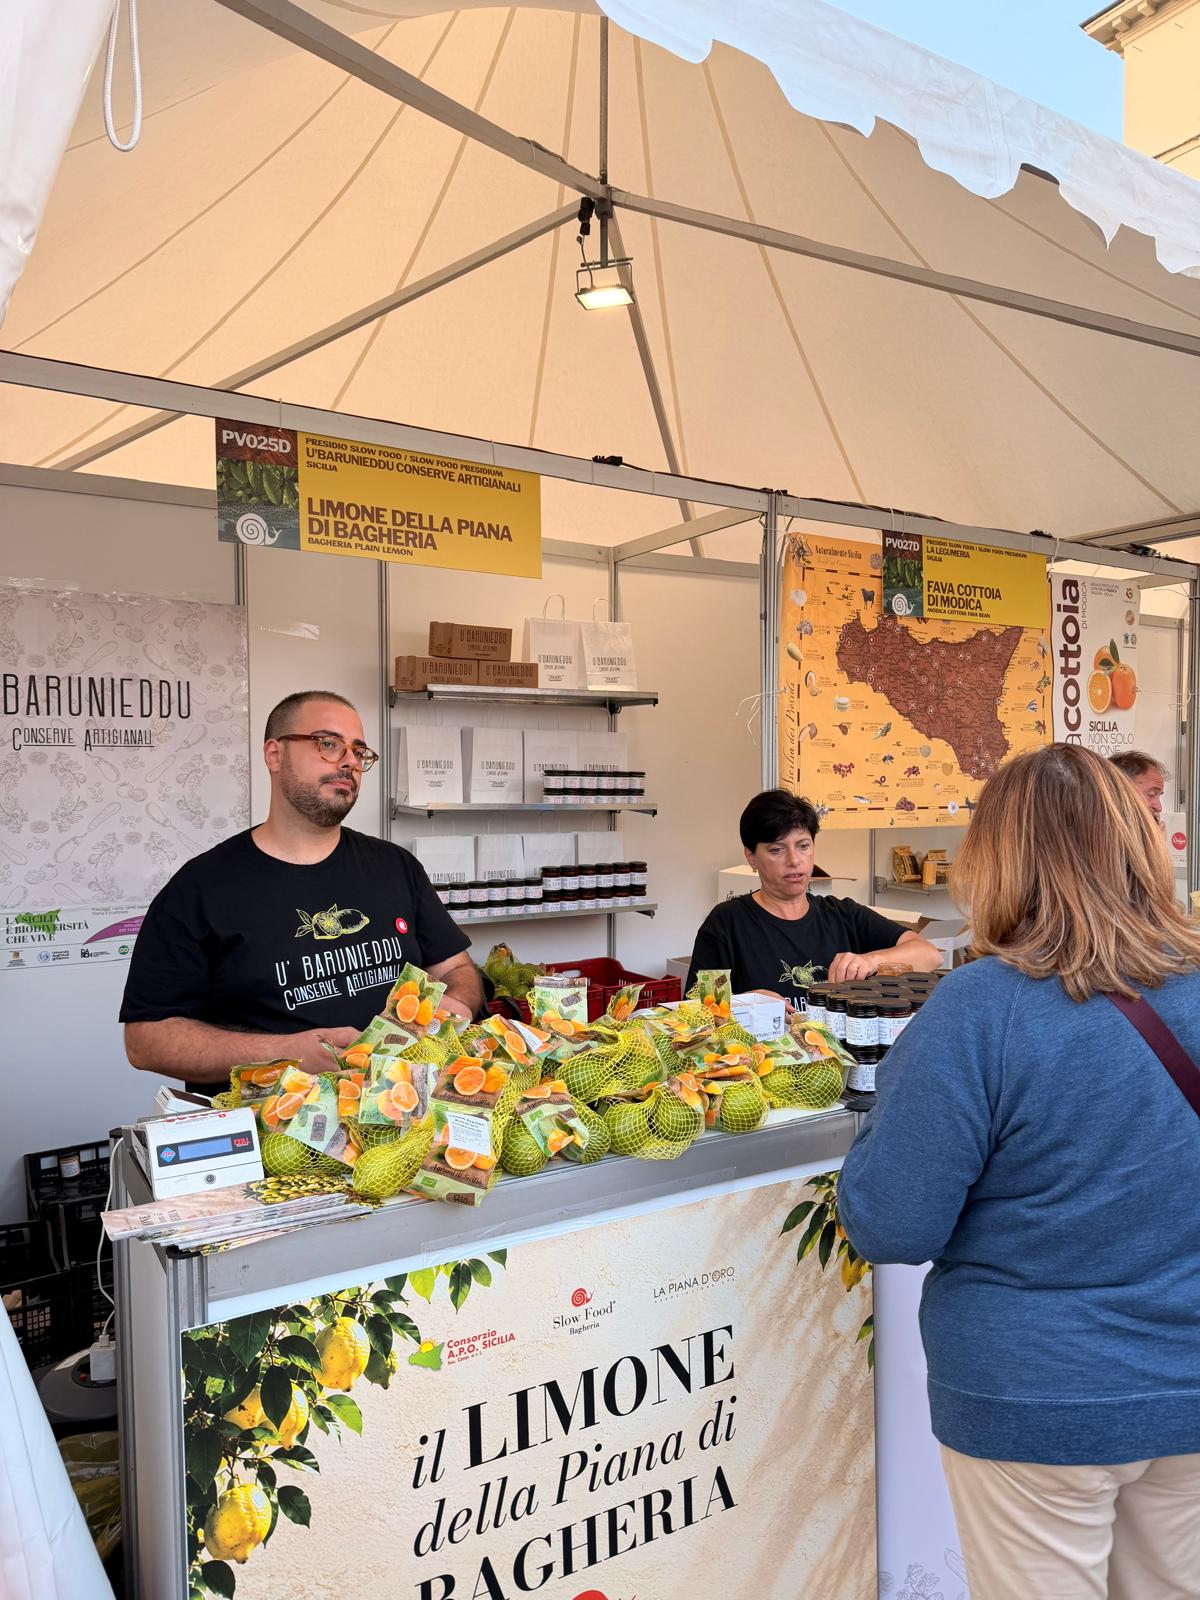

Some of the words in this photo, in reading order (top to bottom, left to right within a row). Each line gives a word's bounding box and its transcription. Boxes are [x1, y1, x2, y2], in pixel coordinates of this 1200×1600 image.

[222, 429, 291, 453] PV025D
[305, 437, 348, 450] PRESIDIO
[350, 445, 376, 455] SLOW
[378, 449, 402, 460] FOOD
[409, 455, 435, 466] SLOW
[436, 460, 459, 470] FOOD
[460, 464, 503, 478] PRESIDIUM
[306, 461, 338, 472] SICILIA
[306, 447, 394, 471] U'BARUNIEDDU
[396, 462, 456, 482] CONSERVE
[457, 472, 521, 493] ARTIGIANALI
[307, 497, 388, 526] LIMONE
[392, 509, 453, 534] DELLA
[457, 518, 513, 542] PIANA
[308, 517, 330, 537] DI
[333, 520, 438, 550] BAGHERIA
[308, 536, 353, 549] BAGHERIA
[354, 542, 380, 553] PLAIN
[382, 546, 414, 557] LEMON
[885, 537, 920, 552] PV027D
[926, 546, 935, 554] LA
[936, 547, 970, 559] LEGUMERIA
[926, 555, 943, 563] SICILIA
[927, 580, 955, 595] FAVA
[957, 584, 1002, 600] COTTOIA
[927, 594, 938, 607] DI
[940, 595, 983, 611] MODICA
[3, 673, 191, 719] BARUNIEDDU
[1089, 721, 1118, 732] SICILIA
[1088, 733, 1108, 744] NON
[1110, 733, 1134, 745] SOLO
[15, 920, 89, 934] BIODIVERSITÀ
[22, 913, 61, 924] SICILIA
[6, 935, 29, 944] CHE
[30, 934, 55, 943] VIVE
[275, 960, 290, 986] U'
[302, 937, 402, 981] BARUNIEDDU
[453, 1193, 468, 1204] Bio
[654, 1287, 666, 1298] LA
[669, 1277, 699, 1294] PIANA
[701, 1267, 735, 1285] D'ORO
[552, 1314, 581, 1329] Slow
[570, 1321, 600, 1335] Bagheria
[447, 1328, 497, 1349] Consorzio
[447, 1344, 479, 1360] A.P.O.
[482, 1333, 516, 1350] SICILIA
[412, 1428, 447, 1489] il
[462, 1325, 735, 1470] LIMONE
[413, 1476, 539, 1558] della
[551, 1430, 686, 1507] Piana
[698, 1395, 738, 1451] di
